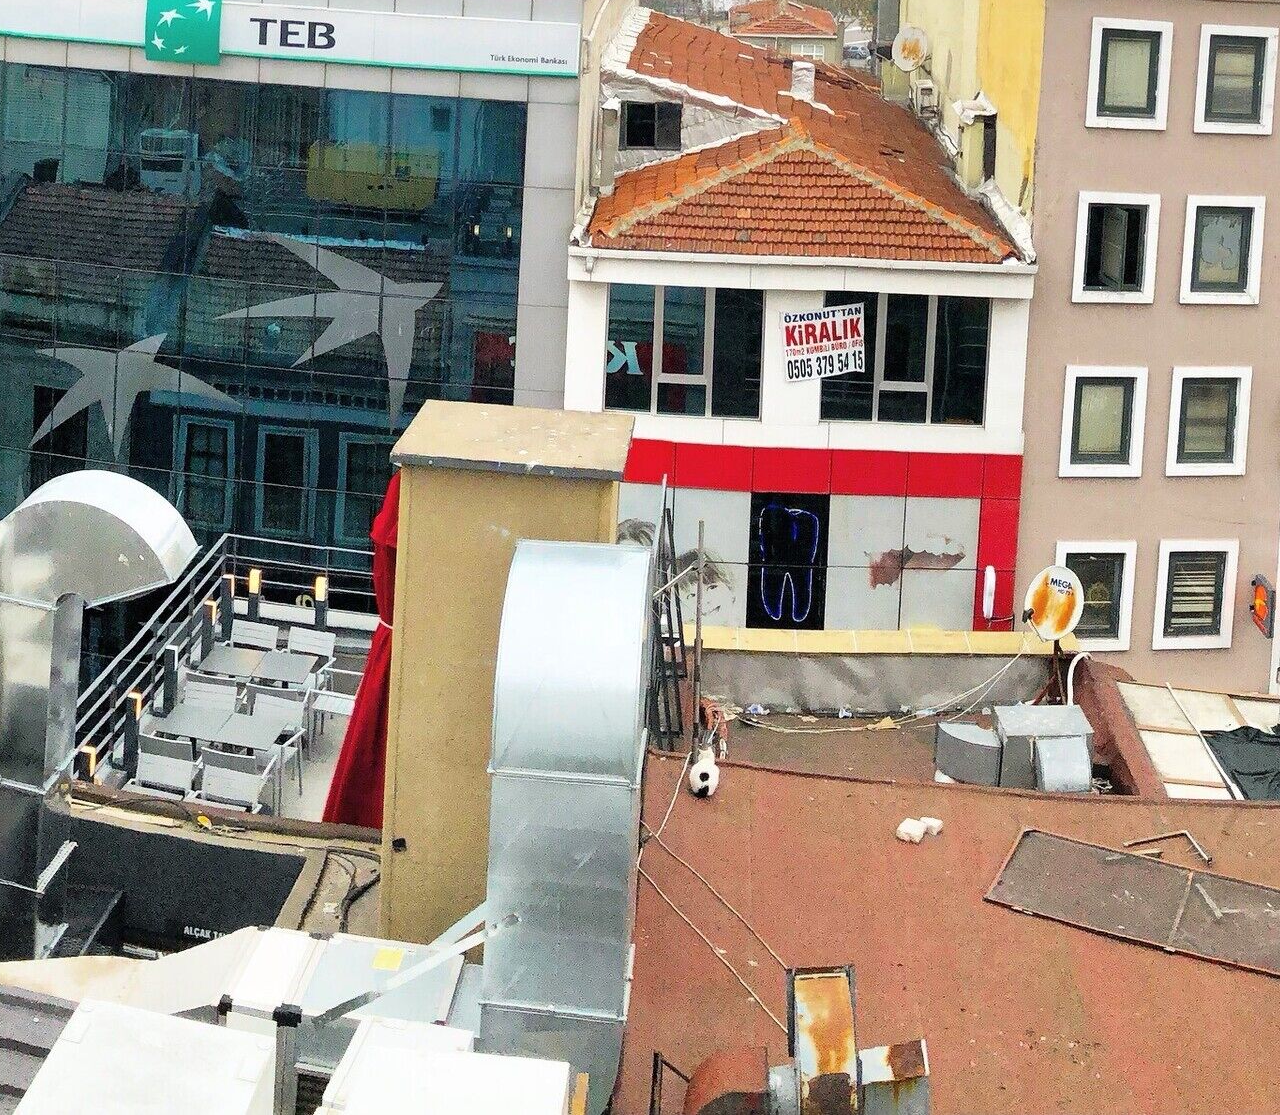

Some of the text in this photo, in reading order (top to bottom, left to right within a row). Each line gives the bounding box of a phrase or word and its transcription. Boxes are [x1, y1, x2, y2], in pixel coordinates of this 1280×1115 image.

[250, 17, 336, 50] TEB
[490, 53, 568, 65] Türk Ekonomi Bankası
[784, 306, 862, 324] ÖZKONUT'TAN
[787, 350, 863, 380] 0505 379 54 15
[1050, 577, 1073, 590] MEGA
[183, 925, 212, 939] ALÇAK
